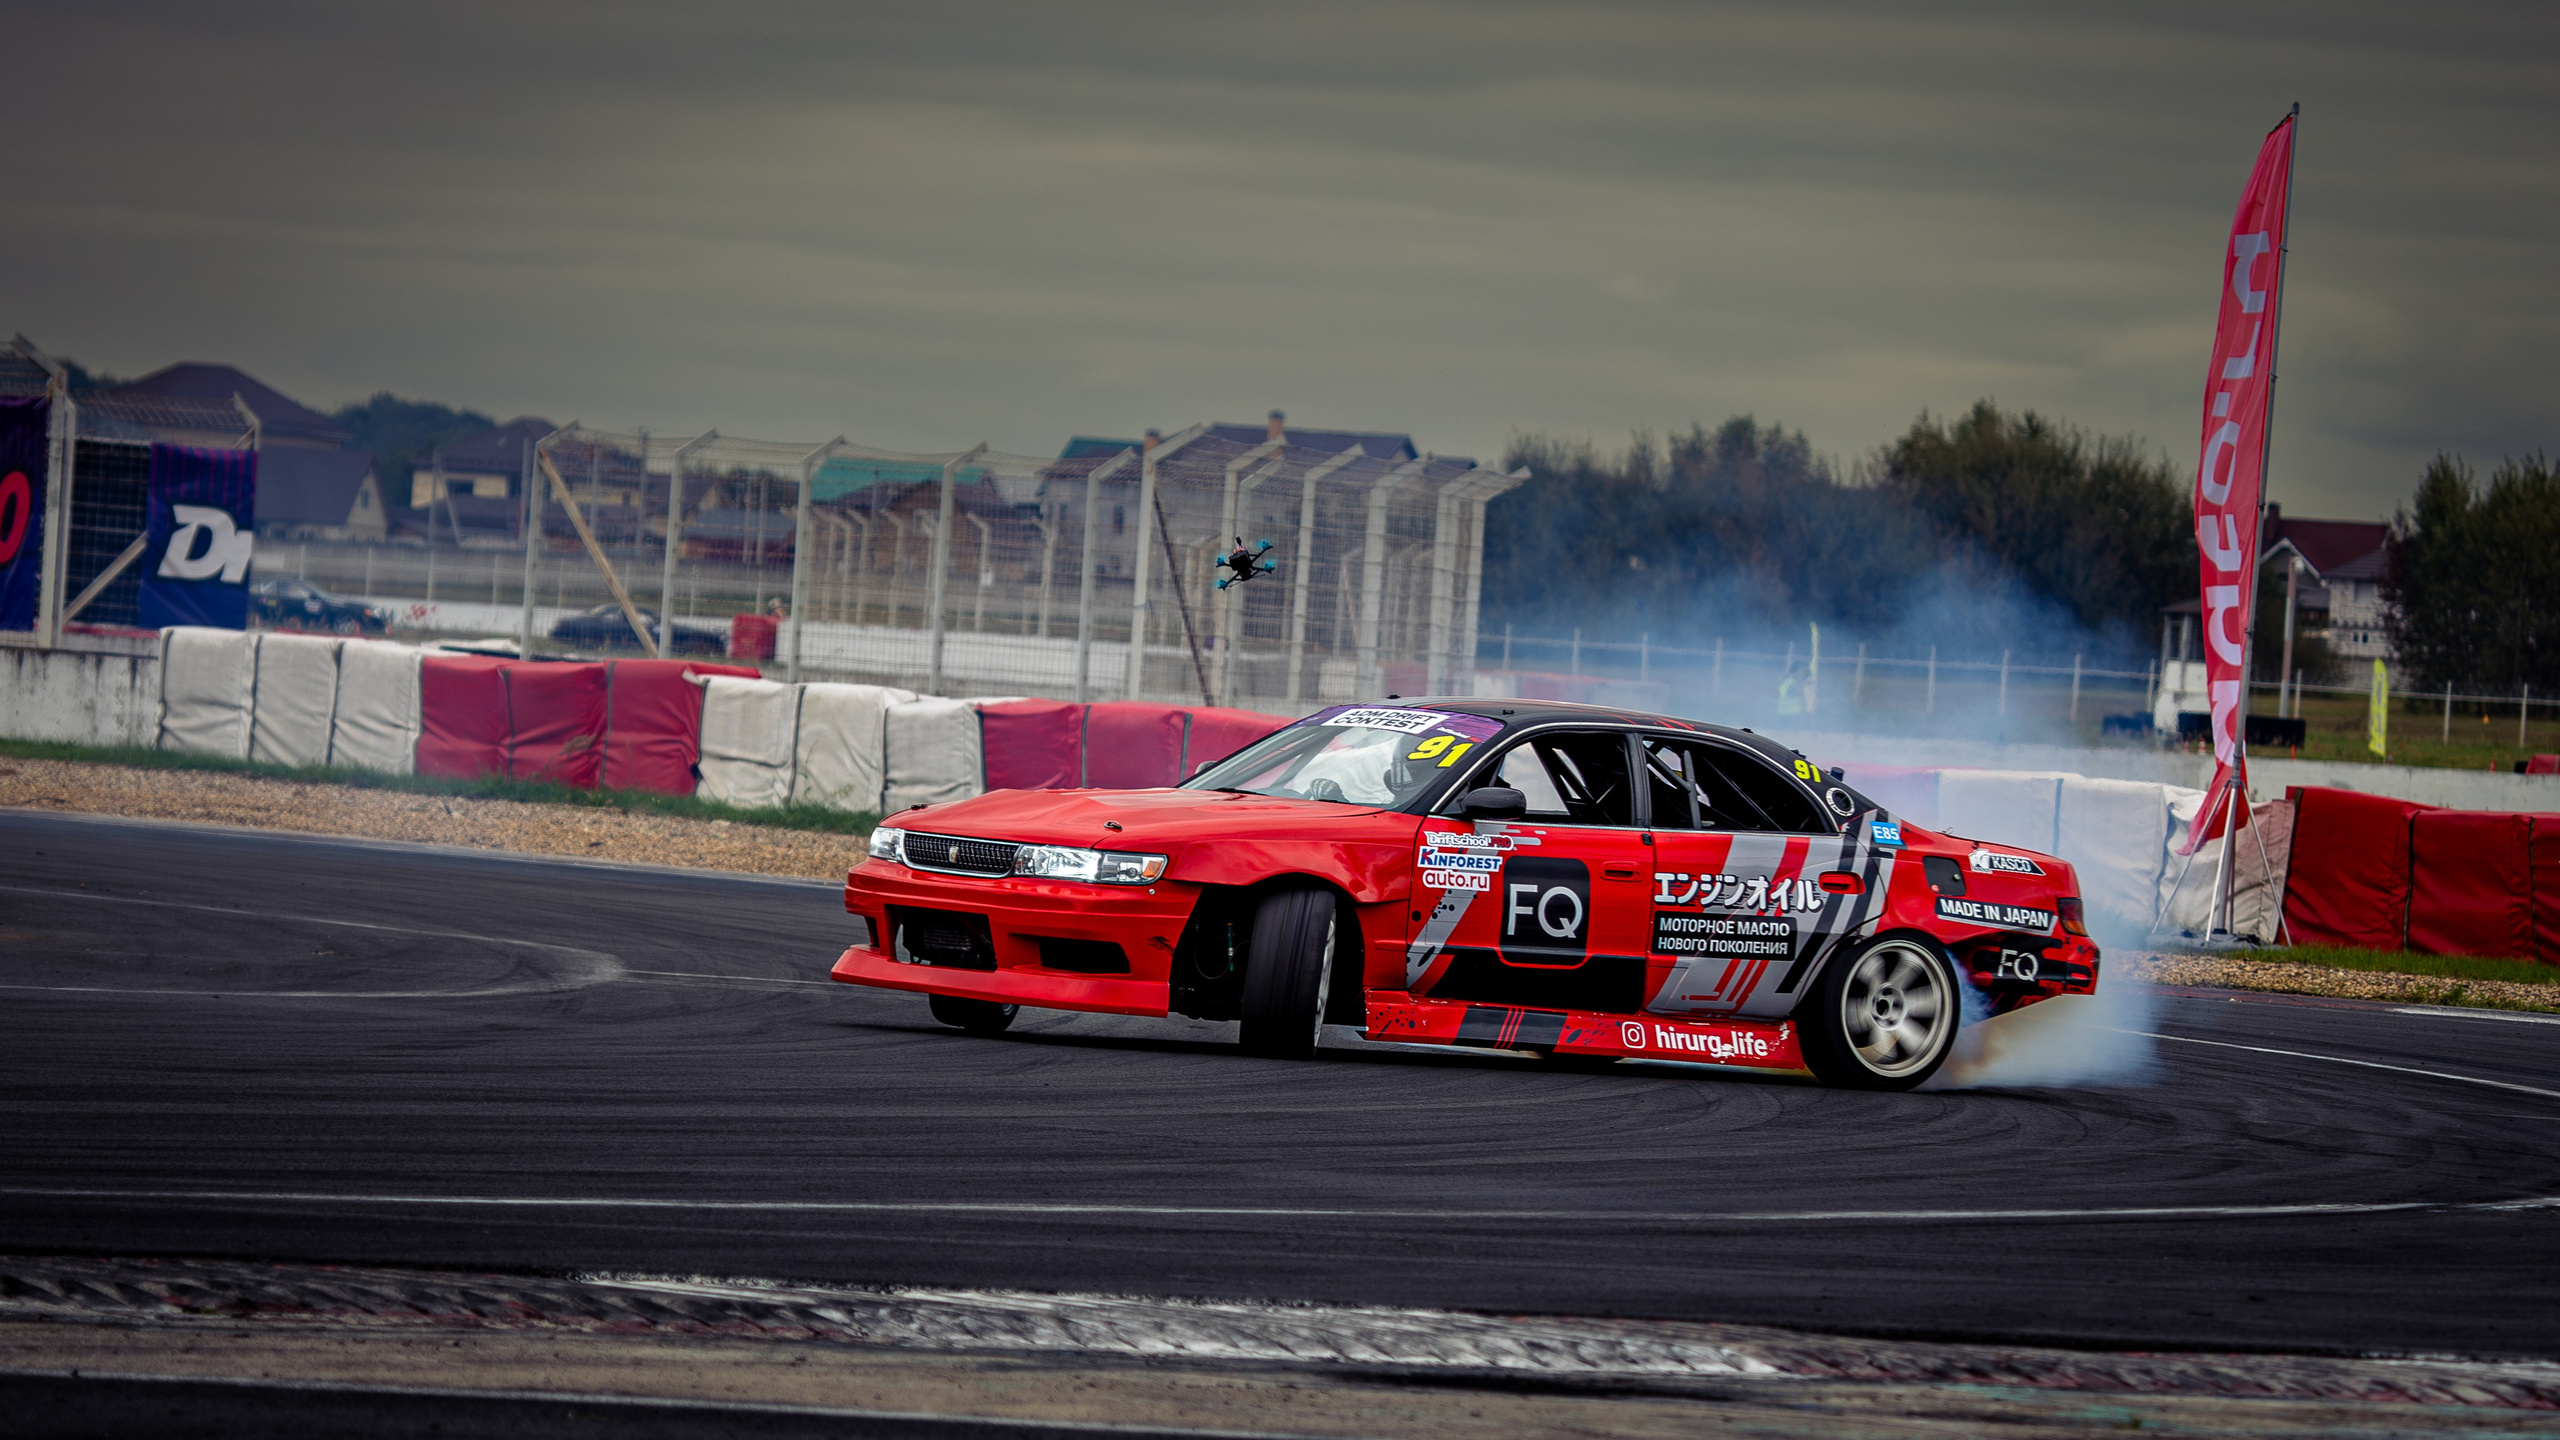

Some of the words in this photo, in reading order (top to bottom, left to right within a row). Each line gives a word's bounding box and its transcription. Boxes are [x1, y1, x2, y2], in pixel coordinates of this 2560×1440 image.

[1333, 716, 1426, 730] CONTEST
[1387, 712, 1437, 723] DRIFT
[1407, 735, 1474, 768] 91
[1793, 759, 1822, 783] 91
[1872, 825, 1900, 841] E85
[1420, 848, 1501, 870] KINFOREST
[1991, 855, 2032, 872] KASCO
[1425, 871, 1488, 889] auto.ru
[1654, 872, 1823, 911] エンジンオイル
[1506, 883, 1583, 939] FQ
[1940, 897, 1982, 919] MADE
[1984, 904, 2001, 921] IN
[2002, 907, 2049, 928] JAPAN
[1659, 917, 1735, 935] МОТОРНОЕ
[1737, 921, 1790, 937] МАСЛО
[1658, 936, 1707, 952] НОВОГО
[1709, 939, 1789, 955] ПОКОЛЕНИЯ
[1997, 949, 2039, 982] FQ
